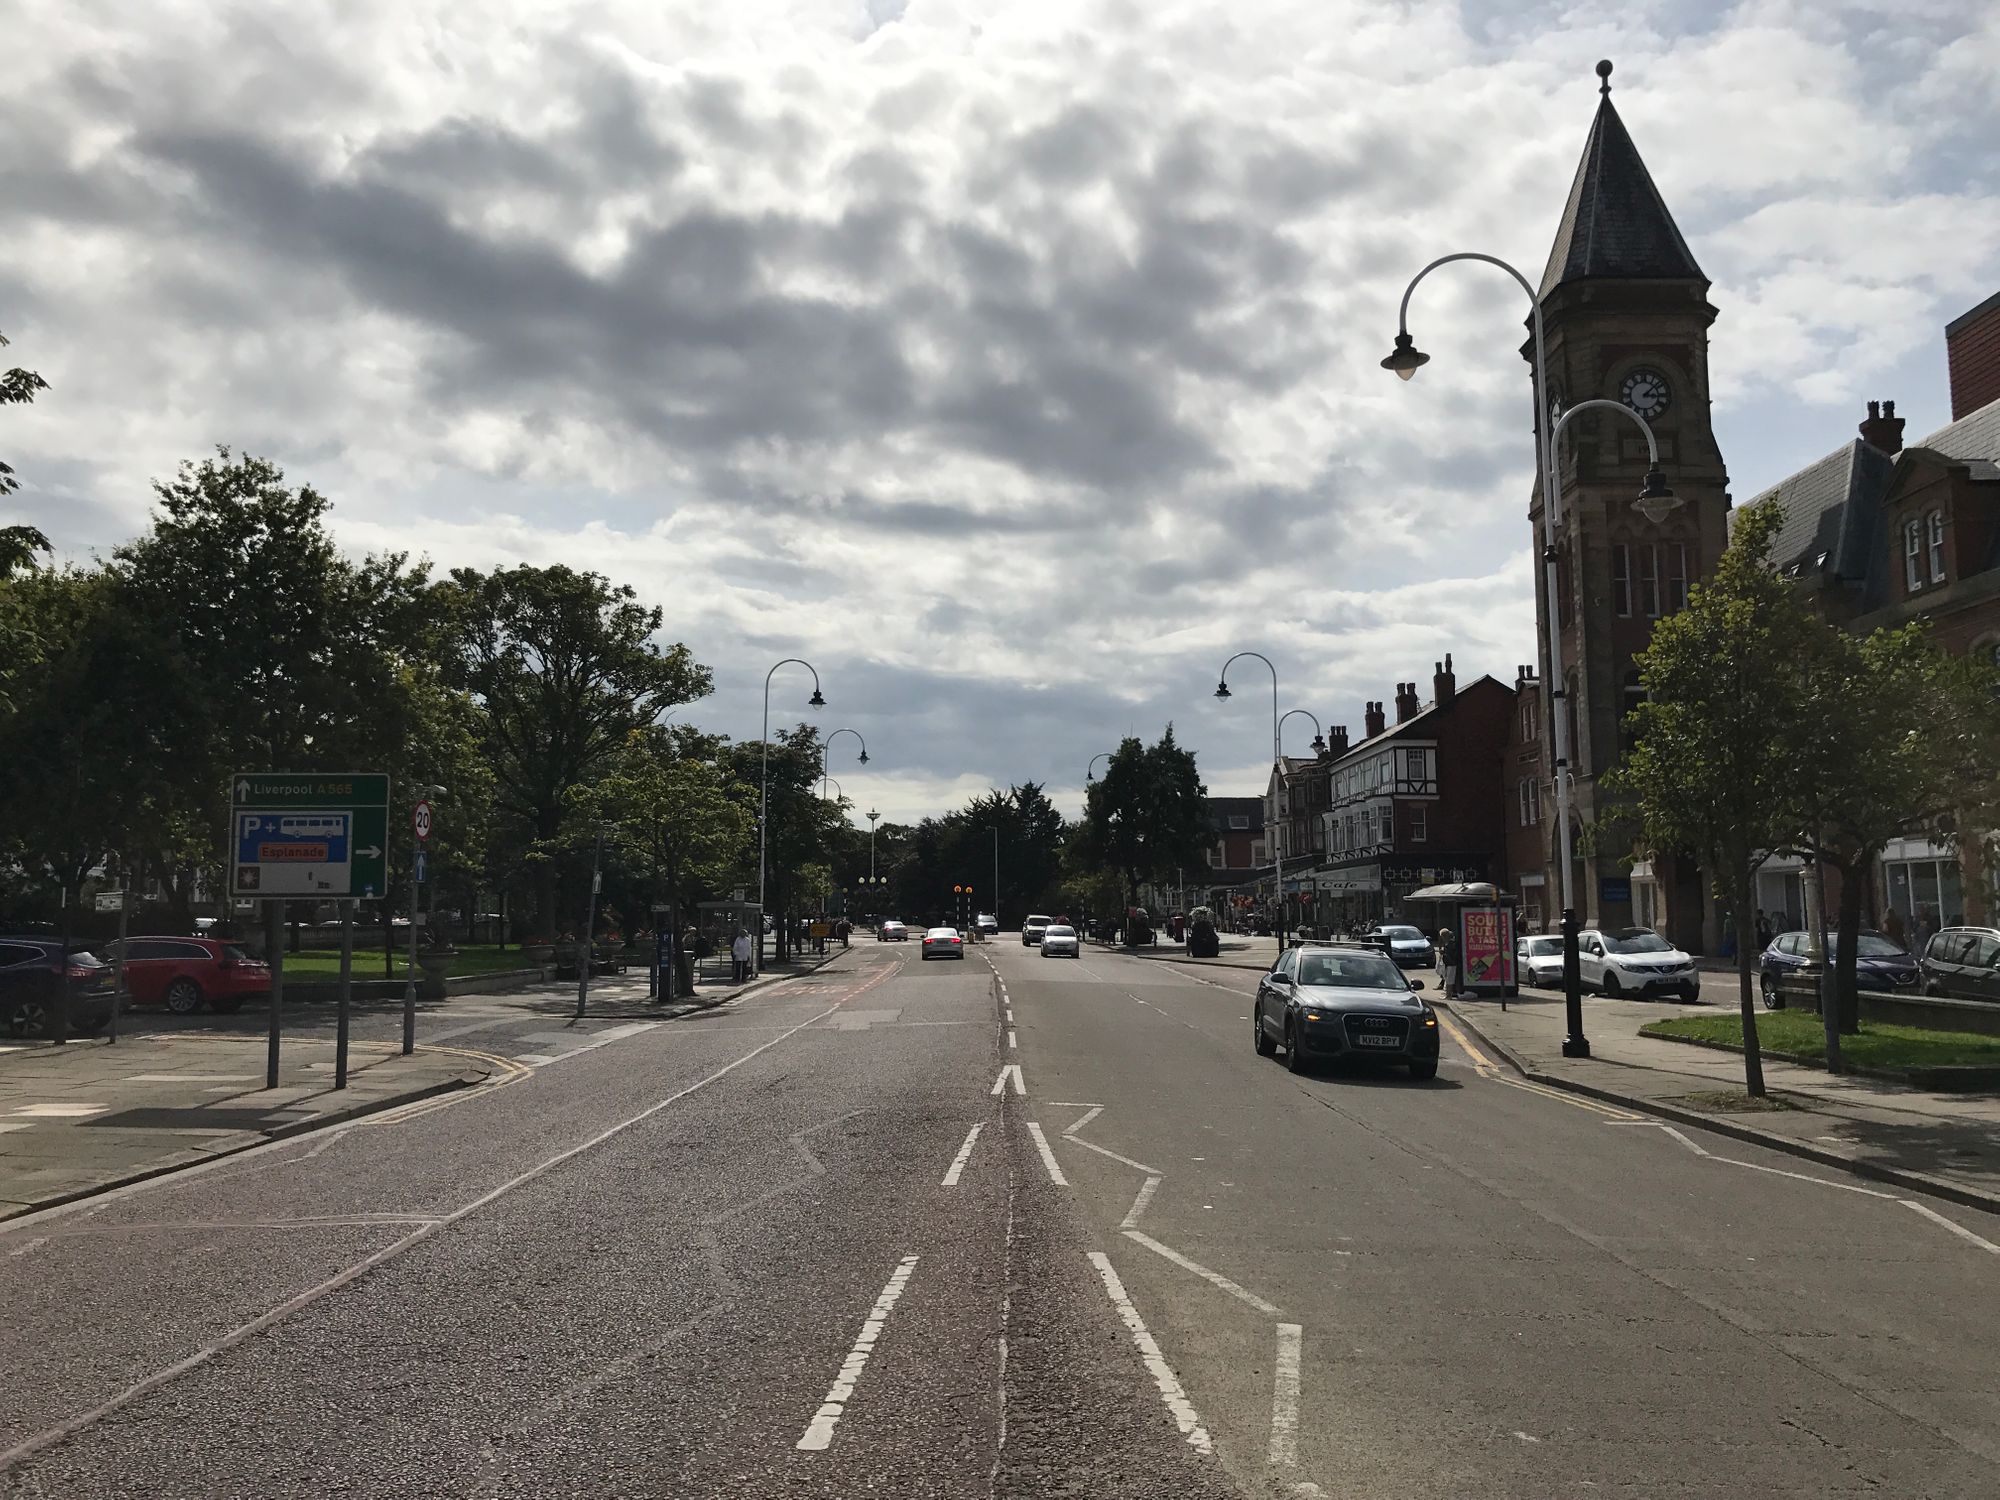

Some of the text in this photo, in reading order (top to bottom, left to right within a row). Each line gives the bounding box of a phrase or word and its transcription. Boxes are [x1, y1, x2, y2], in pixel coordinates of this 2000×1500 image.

[254, 784, 313, 797] Liverpool
[417, 812, 429, 828] 20
[244, 816, 261, 839] P
[262, 847, 324, 860] Esplanade
[1468, 926, 1491, 936] BUT
